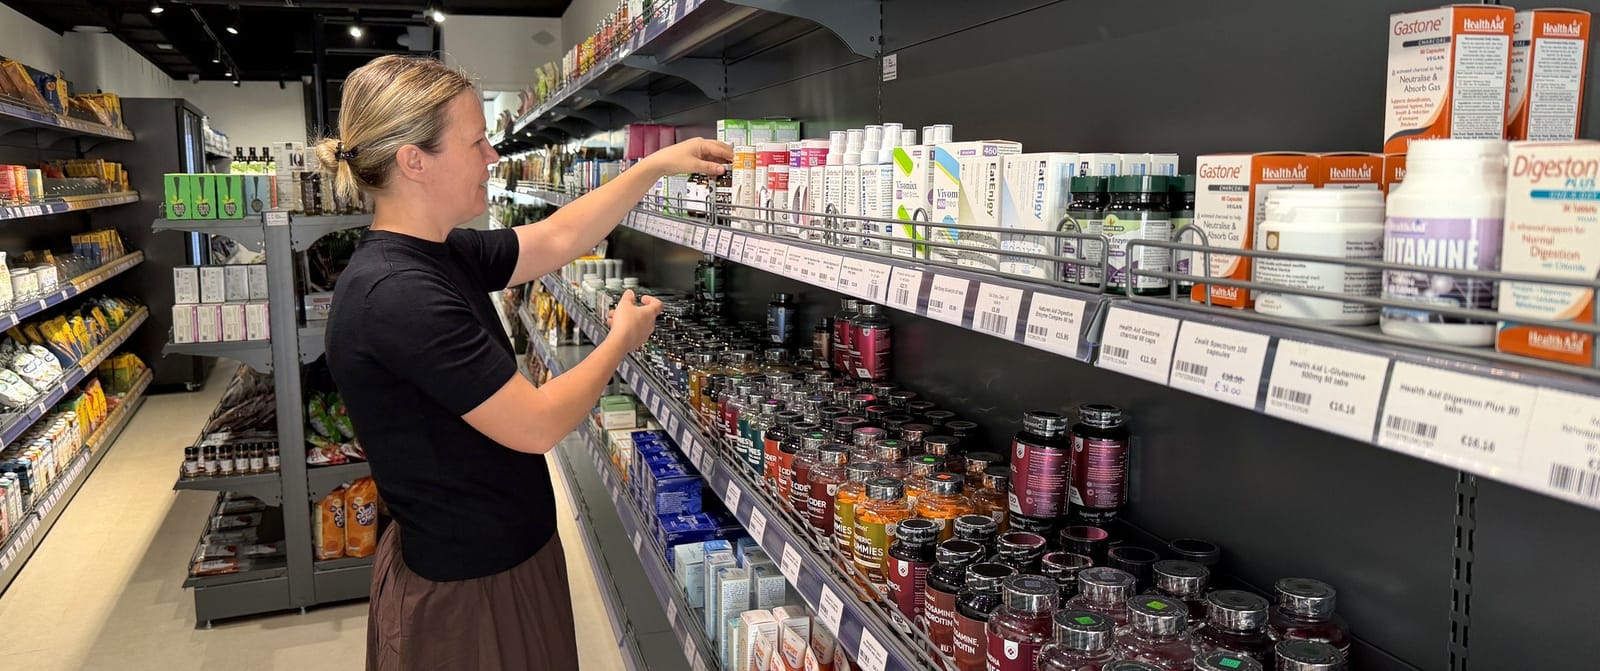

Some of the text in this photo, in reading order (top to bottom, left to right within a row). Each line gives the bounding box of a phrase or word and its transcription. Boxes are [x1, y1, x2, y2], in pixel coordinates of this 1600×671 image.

[1393, 19, 1441, 36] Gastone
[1464, 16, 1504, 30] HealthAid
[1543, 20, 1580, 34] HealthAid
[1400, 73, 1437, 83] Neutralise &
[1404, 83, 1441, 92] Absorb Gas
[983, 146, 997, 156] 460
[1200, 163, 1240, 179] Gastone
[1262, 164, 1307, 178] HealthAid
[1330, 164, 1371, 178] HealthAid
[1513, 154, 1599, 183] Digeston
[1565, 177, 1596, 187] PLUS
[986, 162, 996, 217] EatEnjoy
[1034, 160, 1046, 220] EatEnjoy
[1203, 221, 1230, 230] Neutralise
[1207, 231, 1239, 240] Absorb Gas
[1530, 246, 1580, 261] Digestion
[1210, 339, 1236, 352] Spectrum
[1528, 330, 1584, 352] HealthAid
[1206, 348, 1230, 359] capsules
